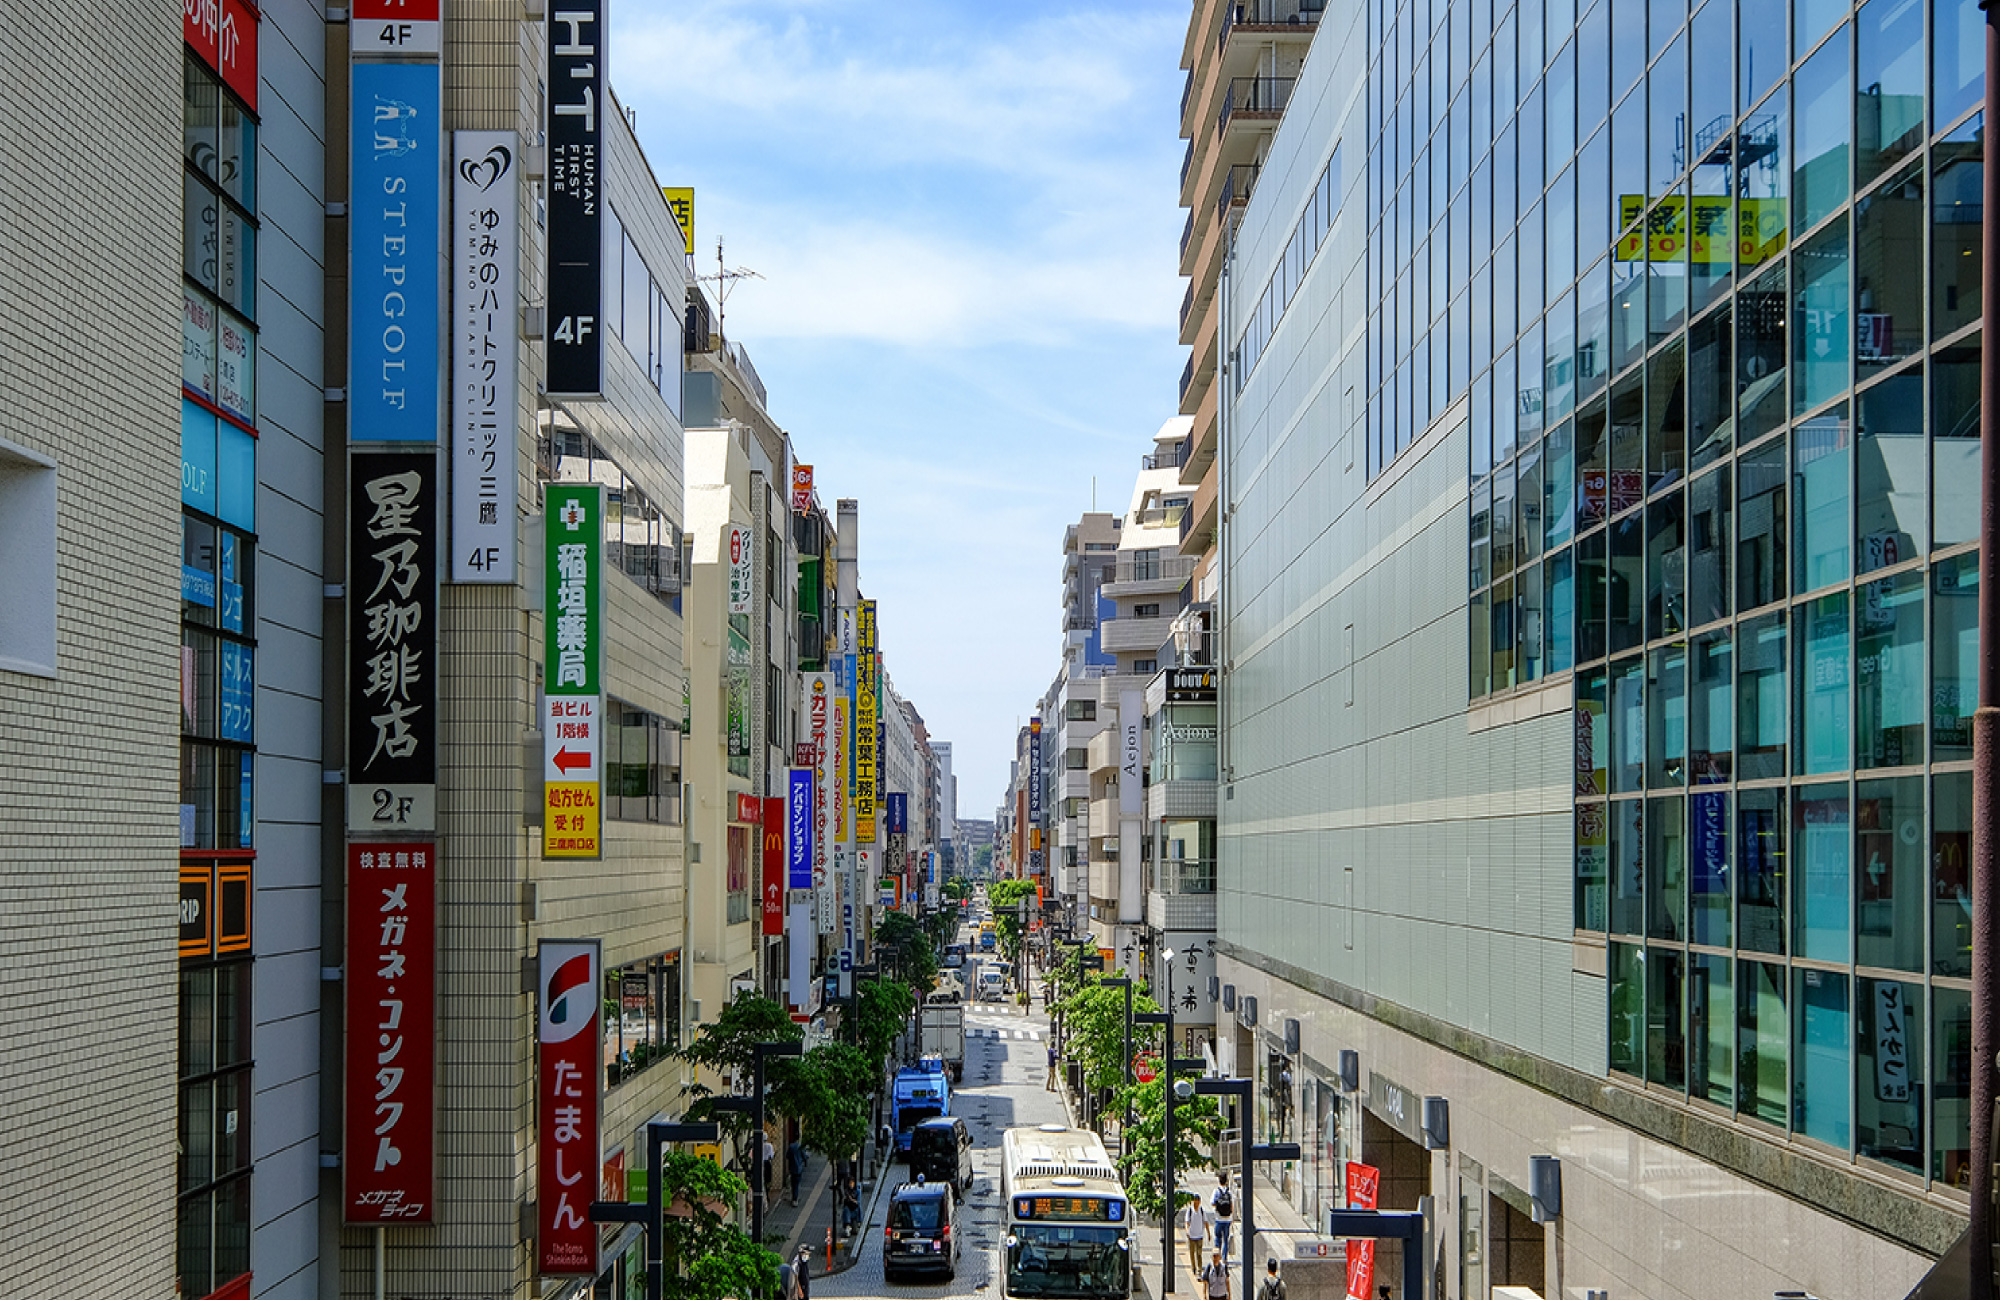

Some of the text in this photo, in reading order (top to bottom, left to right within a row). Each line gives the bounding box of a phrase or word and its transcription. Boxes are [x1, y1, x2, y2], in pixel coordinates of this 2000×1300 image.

[379, 24, 413, 45] 4F
[554, 11, 594, 132] H1T
[554, 144, 565, 192] TIME
[569, 144, 579, 199] FIRST
[584, 144, 594, 215] HUMAN
[382, 176, 407, 410] STEPGOLF
[466, 208, 476, 457] YUMINO HEART CLINIC
[554, 315, 594, 345] 4F
[478, 206, 500, 526] ゆみのハートクリニック三鷹
[467, 547, 500, 571] 4F
[362, 471, 422, 771] 星乃珈琲店
[557, 543, 587, 688] 稲垣薬局
[551, 701, 592, 717] 当ビル
[555, 722, 590, 739] 1階横
[857, 727, 873, 815] 常葉工務店
[1124, 725, 1140, 778] Aejon
[373, 789, 414, 823] 2F
[548, 788, 596, 808] 処方せん
[554, 814, 585, 831] 受付
[359, 851, 427, 869] 検査無料
[766, 902, 781, 913] 50m
[374, 883, 408, 1172] メガネ・コンタクト
[553, 1058, 585, 1230] たましん
